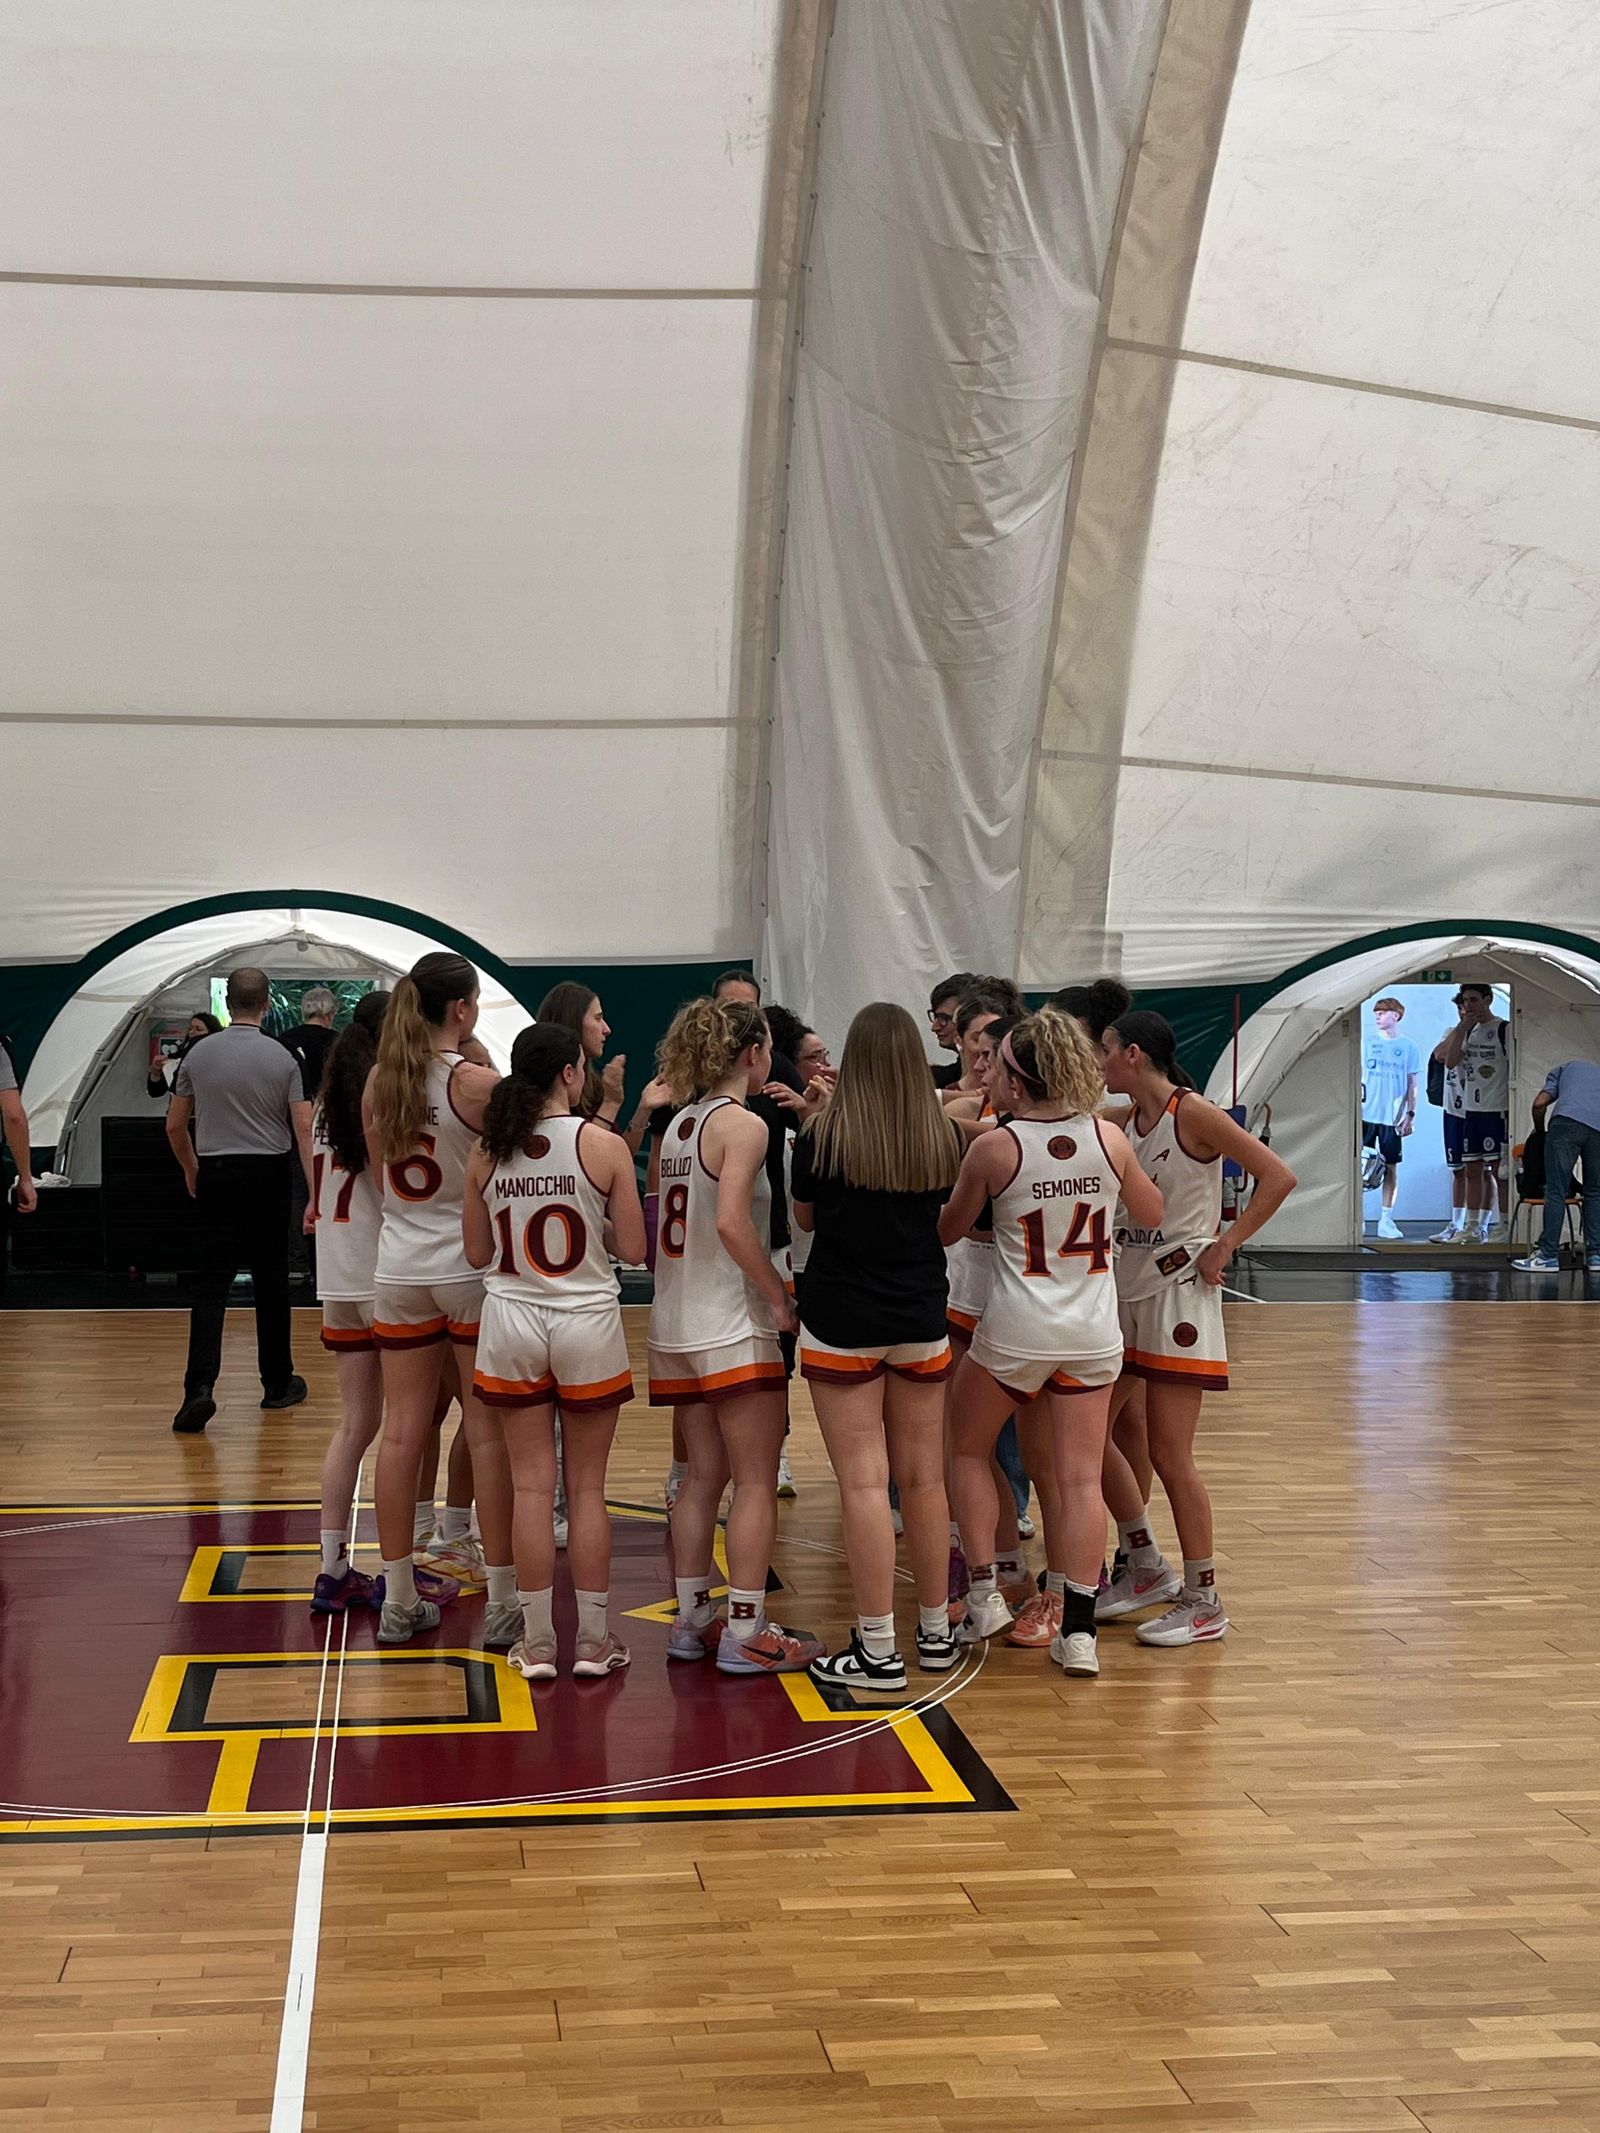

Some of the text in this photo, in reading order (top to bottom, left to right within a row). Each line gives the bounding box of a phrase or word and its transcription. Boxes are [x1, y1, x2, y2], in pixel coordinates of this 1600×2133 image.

[313, 1153, 357, 1223] 17
[388, 1131, 443, 1203] 6
[495, 1175, 576, 1199] MANOCCHIO
[1032, 1176, 1100, 1200] SEMONES
[495, 1203, 587, 1278] 10
[660, 1184, 690, 1259] 8
[1017, 1201, 1112, 1277] 14
[1127, 1528, 1152, 1549] B
[1198, 1568, 1215, 1588] B
